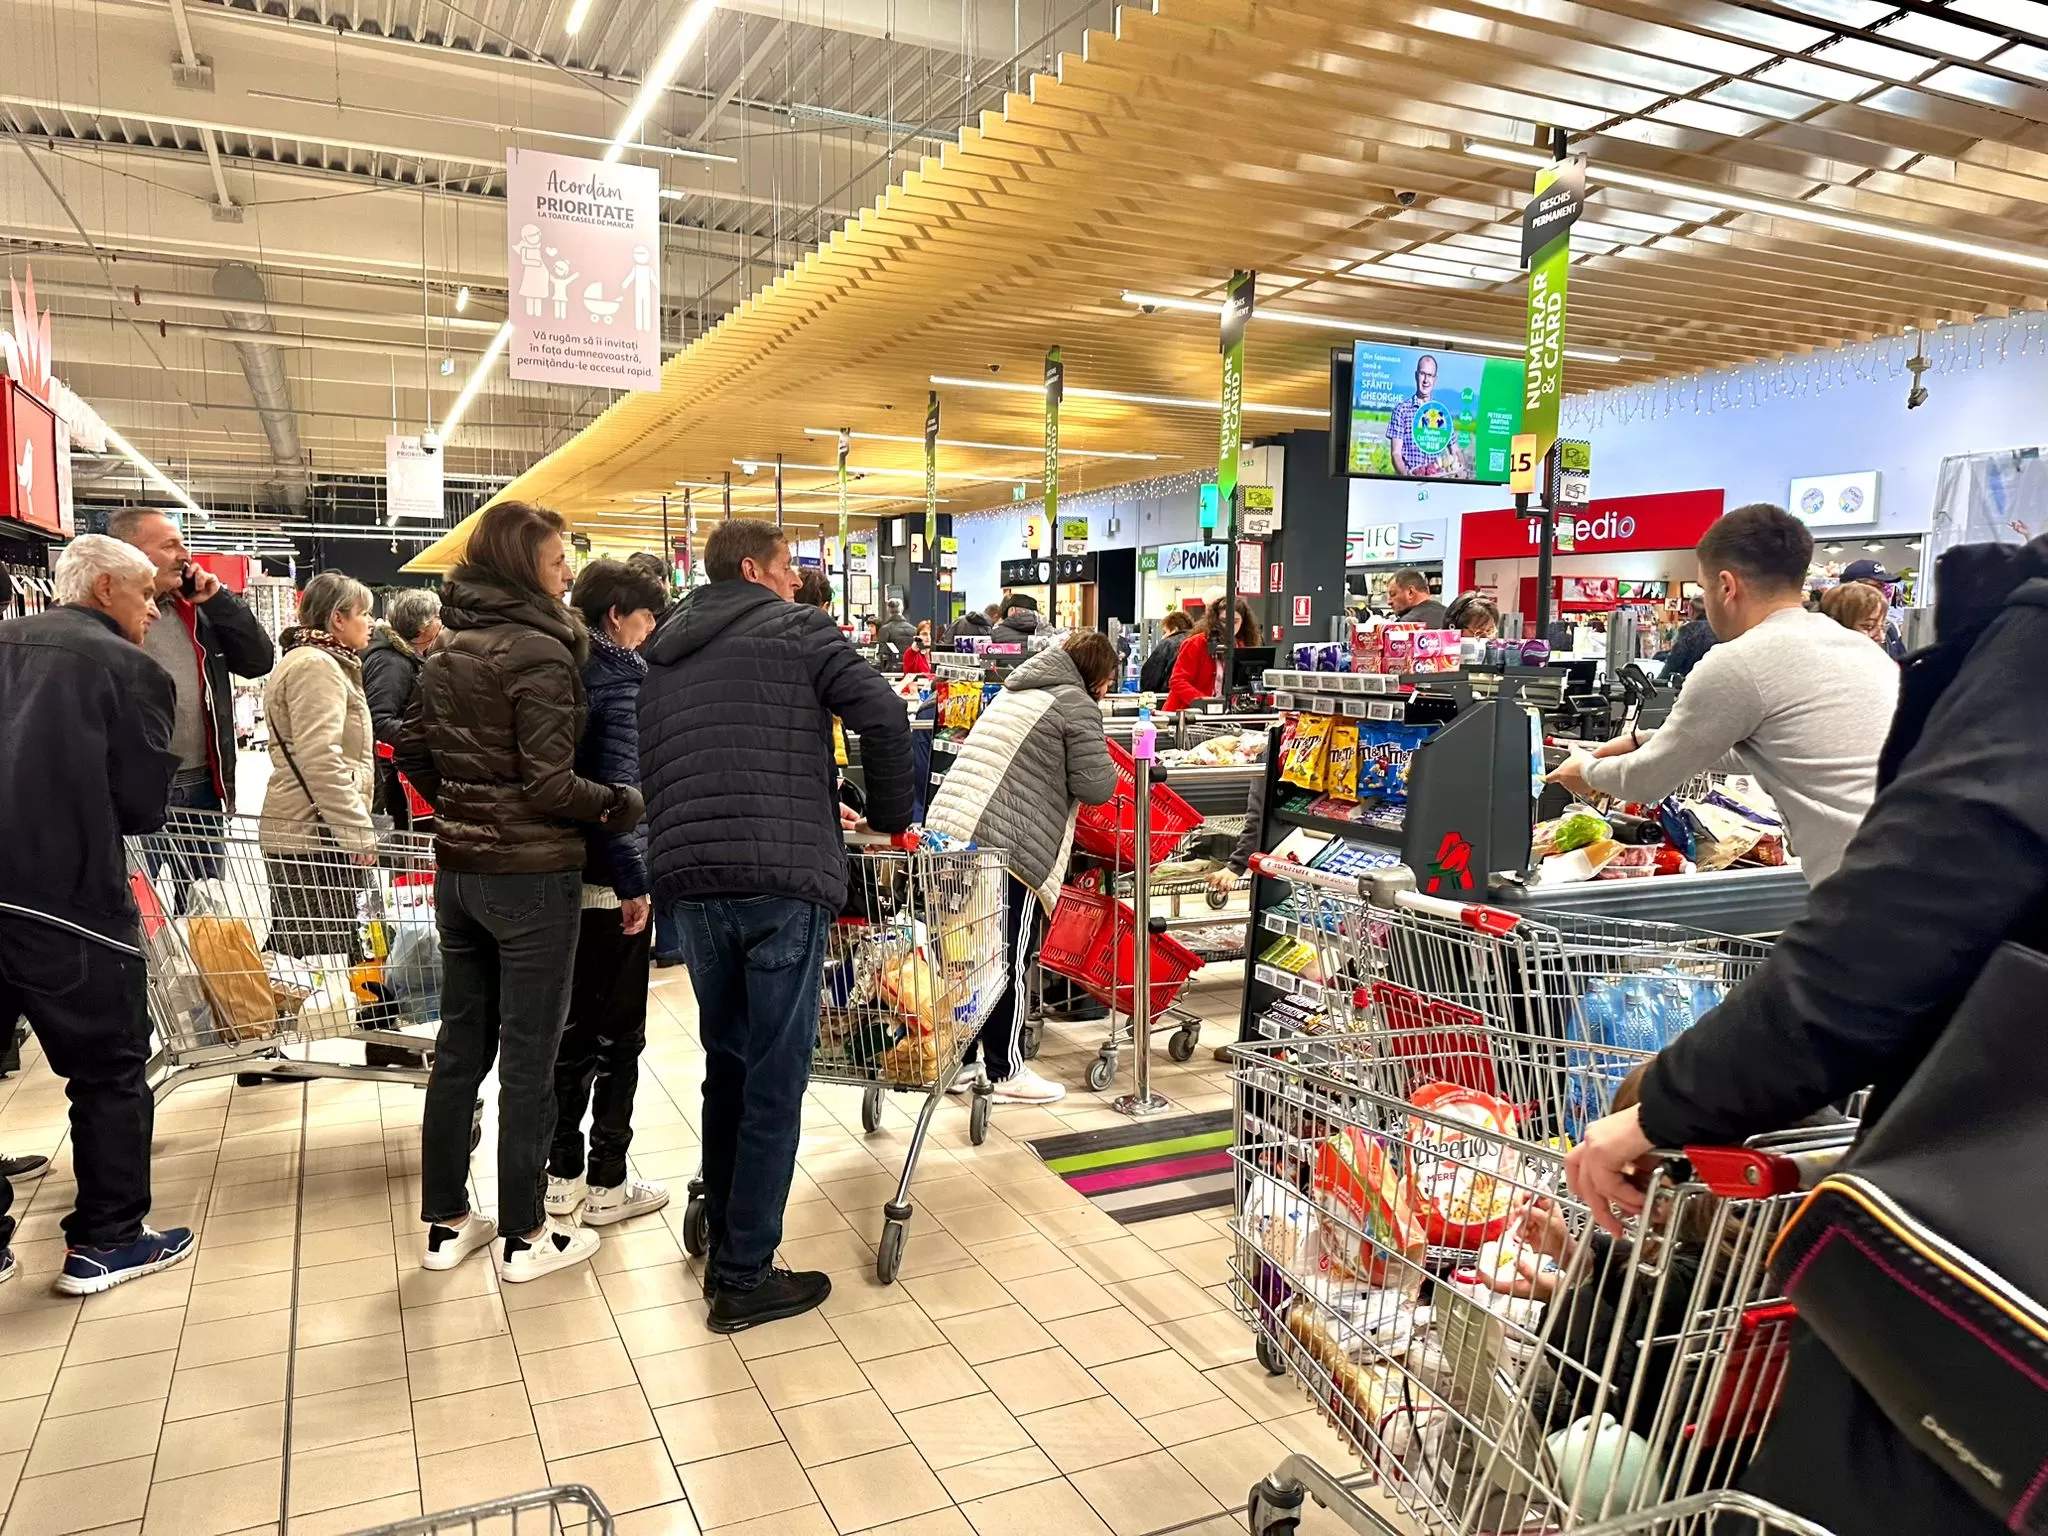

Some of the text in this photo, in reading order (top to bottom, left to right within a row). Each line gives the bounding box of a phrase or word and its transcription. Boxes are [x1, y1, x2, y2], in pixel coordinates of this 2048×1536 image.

[547, 169, 622, 200] Acordăm
[537, 196, 634, 221] PRIORITATE
[1539, 190, 1571, 212] DESCHIS
[548, 213, 570, 221] TOATE
[571, 215, 595, 225] CASELE
[606, 220, 634, 230] MARCAT
[1532, 202, 1578, 229] PERMANENT
[533, 330, 547, 341] Vă
[549, 334, 580, 345] rugăm
[583, 337, 593, 345] să
[1526, 269, 1548, 411] NUMERAR
[1541, 292, 1562, 394] & CARD
[529, 343, 539, 352] în
[564, 347, 641, 364] dumneavoastră,
[590, 364, 625, 375] accesul
[627, 367, 654, 378] rapid.
[1361, 378, 1392, 390] SFÂNTU
[1230, 372, 1240, 430] CARD
[1360, 390, 1404, 402] GHEORGHE
[1221, 356, 1232, 459] NUMERAR
[1510, 453, 1531, 472] 15
[1028, 526, 1034, 537] 3
[912, 544, 918, 553] 2
[1142, 556, 1156, 568] Kids
[1413, 1138, 1498, 1165] Cheerios
